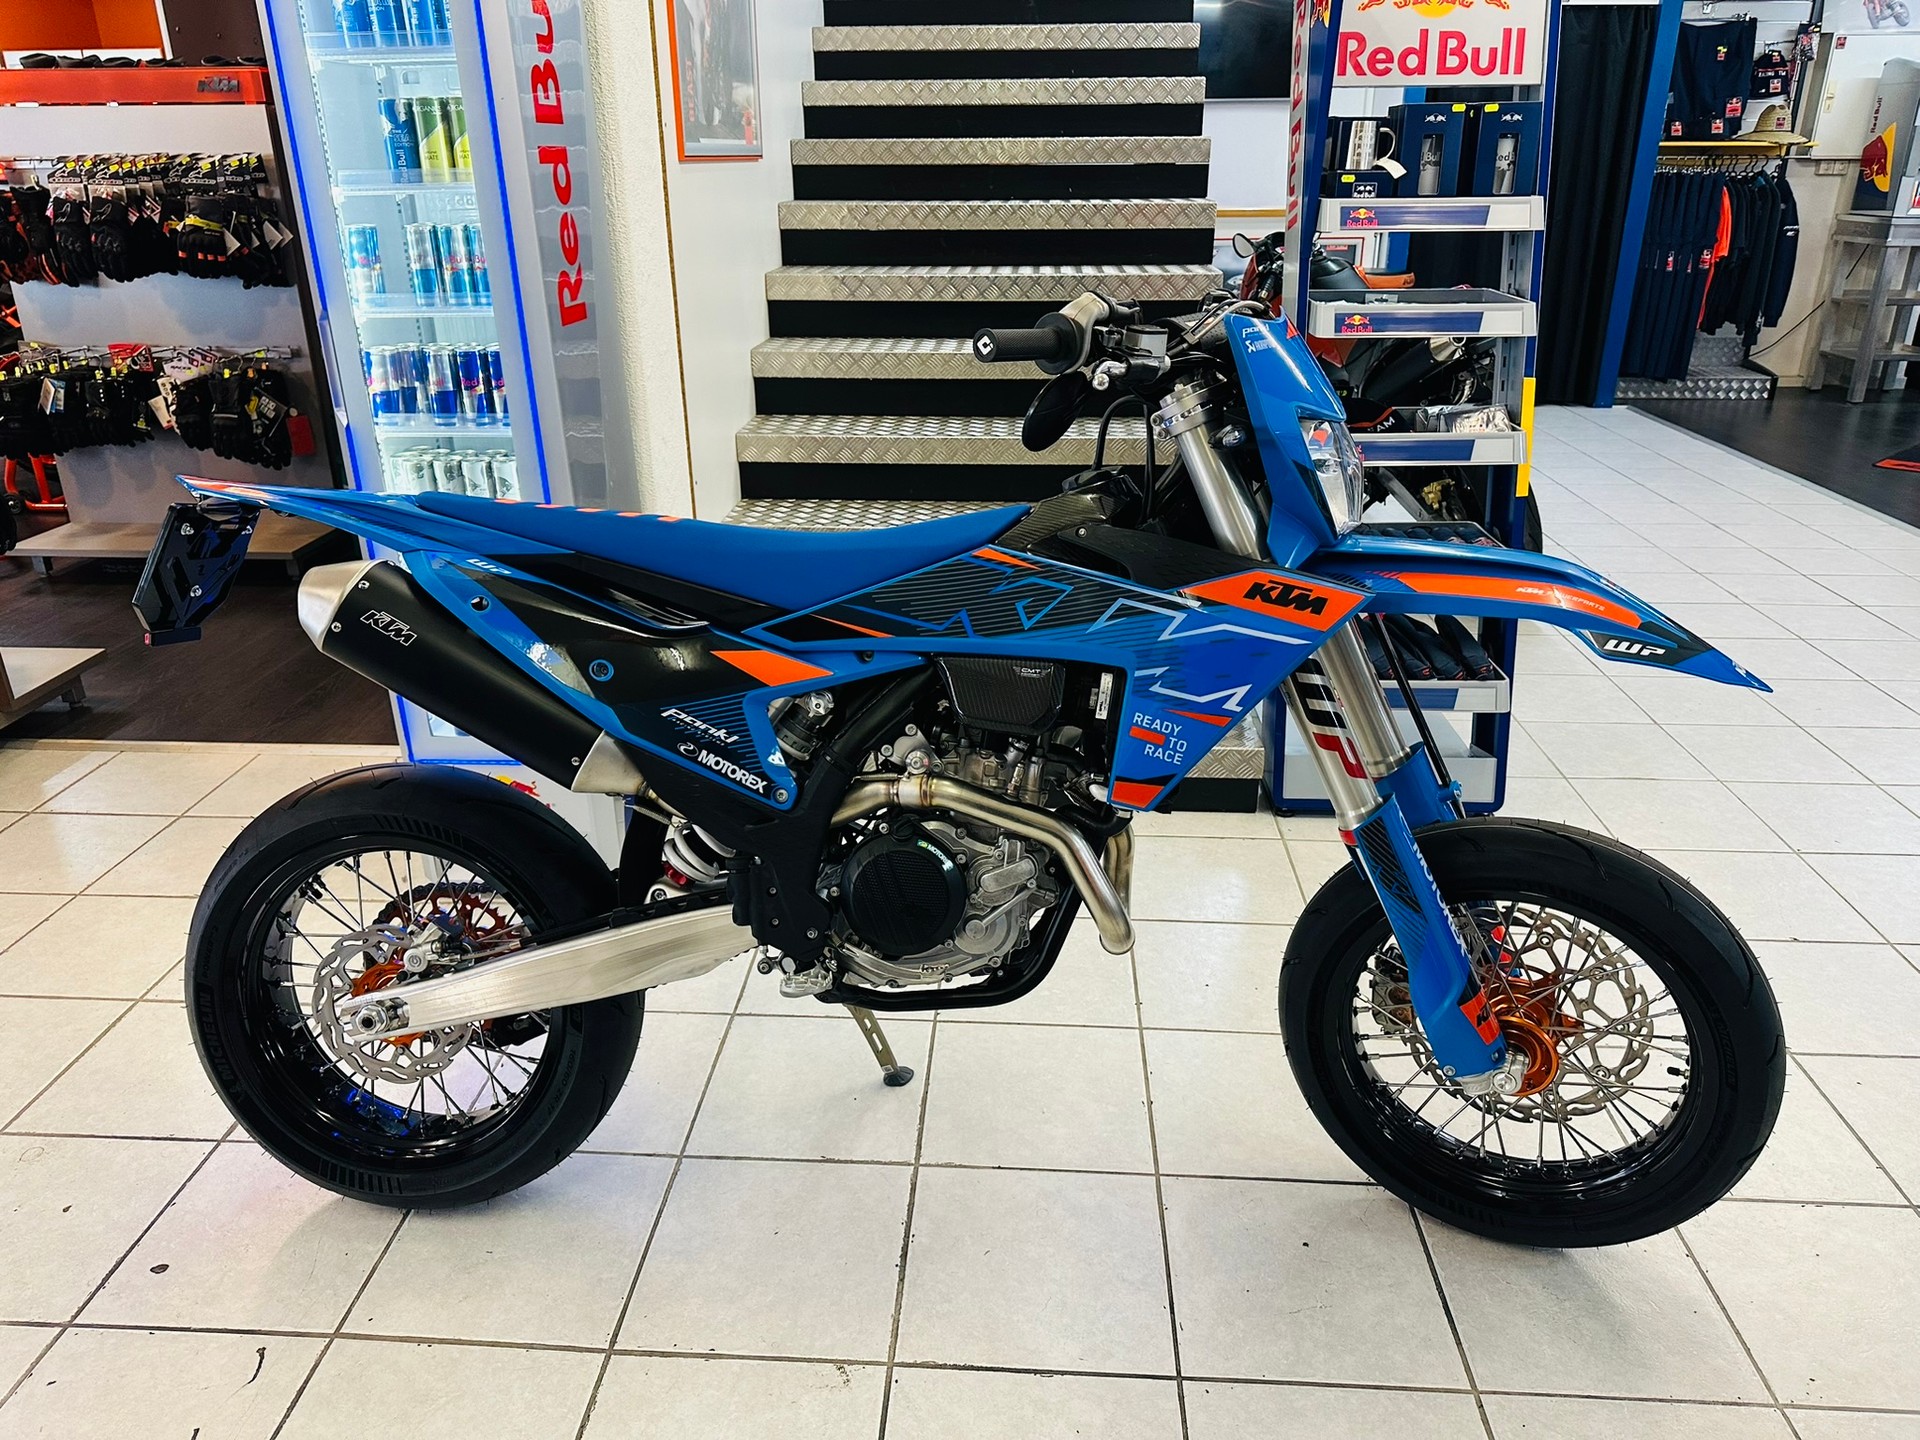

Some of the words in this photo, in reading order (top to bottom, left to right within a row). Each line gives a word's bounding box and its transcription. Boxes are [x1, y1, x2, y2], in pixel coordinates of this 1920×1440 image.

[1336, 28, 1430, 77] Red
[1435, 27, 1527, 77] Bull
[197, 76, 240, 93] KTM
[395, 149, 407, 166] Bull
[1287, 117, 1302, 230] Bull
[1346, 219, 1362, 228] Red
[1362, 219, 1379, 228] Bull
[536, 146, 588, 327] Red
[1341, 325, 1357, 334] Red
[1358, 325, 1373, 334] Bull
[1242, 579, 1329, 616] KTM
[359, 609, 418, 647] KTM
[1603, 639, 1666, 656] WP
[1133, 712, 1183, 736] READY
[1144, 744, 1184, 765] RACE
[1169, 737, 1187, 752] TO
[697, 749, 768, 793] MOTOREX
[199, 991, 234, 1082] MICHELIN
